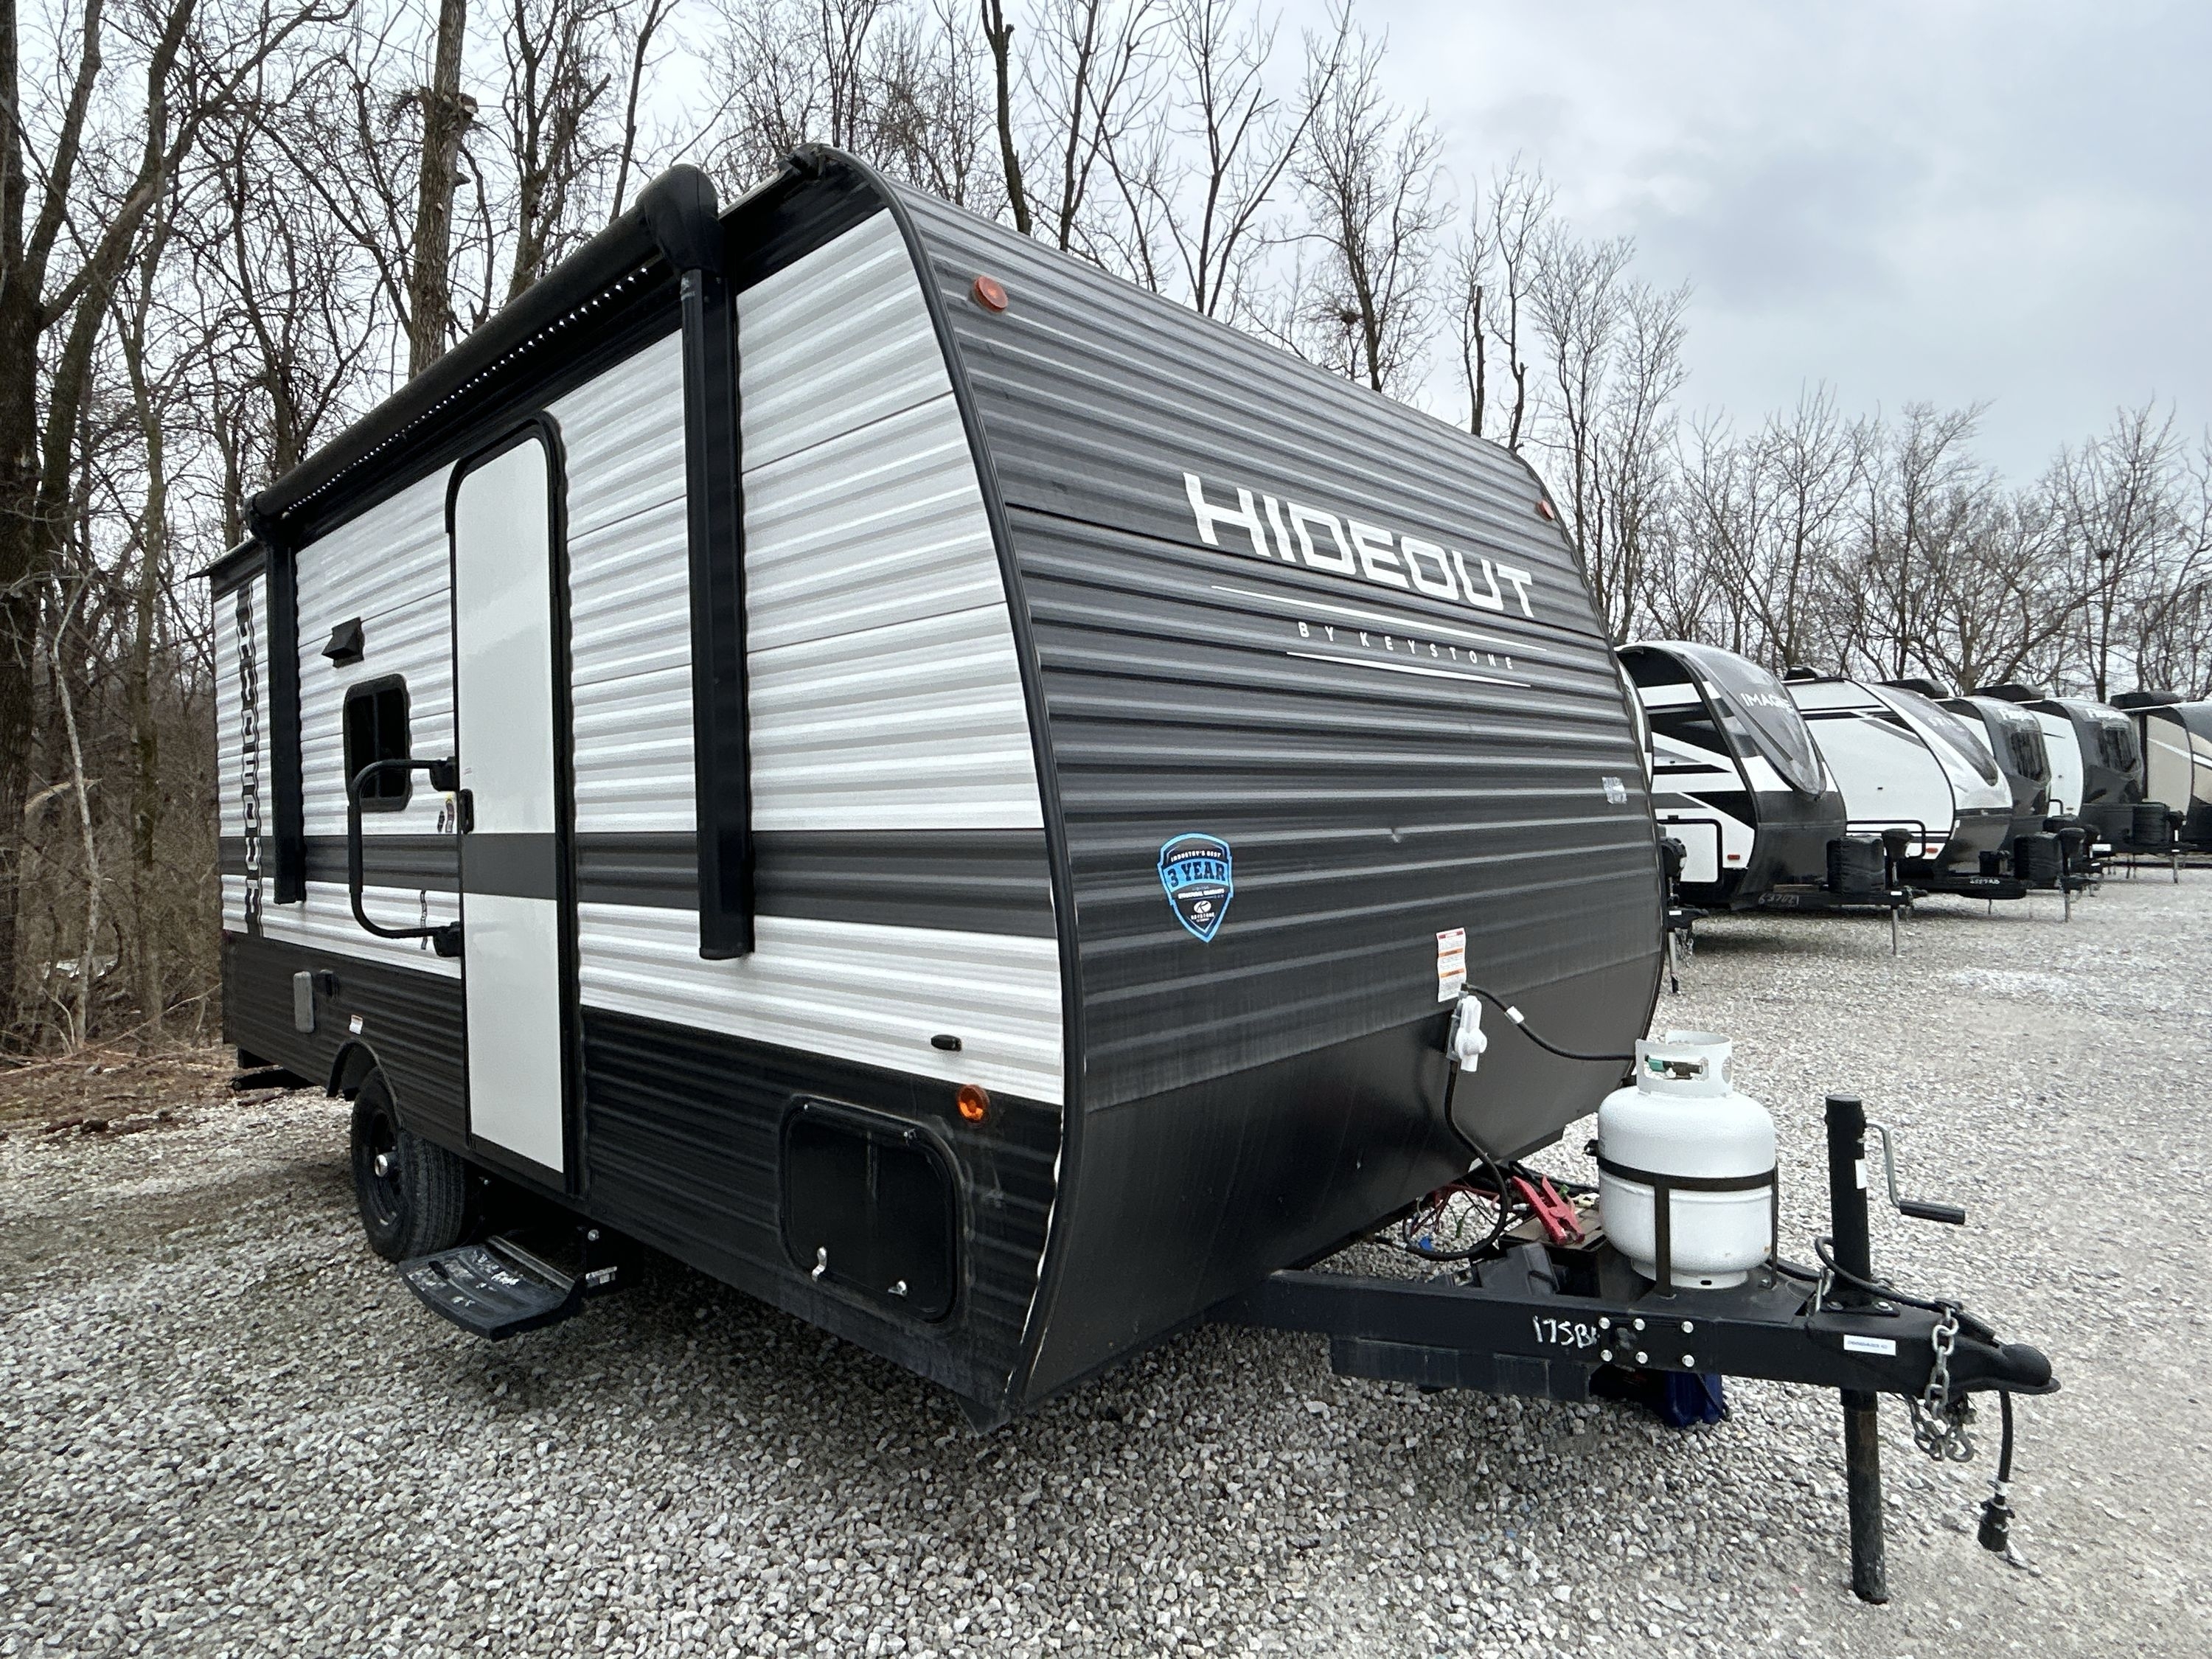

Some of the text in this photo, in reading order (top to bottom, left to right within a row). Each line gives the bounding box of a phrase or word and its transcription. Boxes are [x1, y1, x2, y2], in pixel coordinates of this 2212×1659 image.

[1183, 473, 1534, 618] HIDEOUT
[1298, 622, 1514, 669] BY KEYSTONE
[1167, 861, 1226, 888] 3 YEAR
